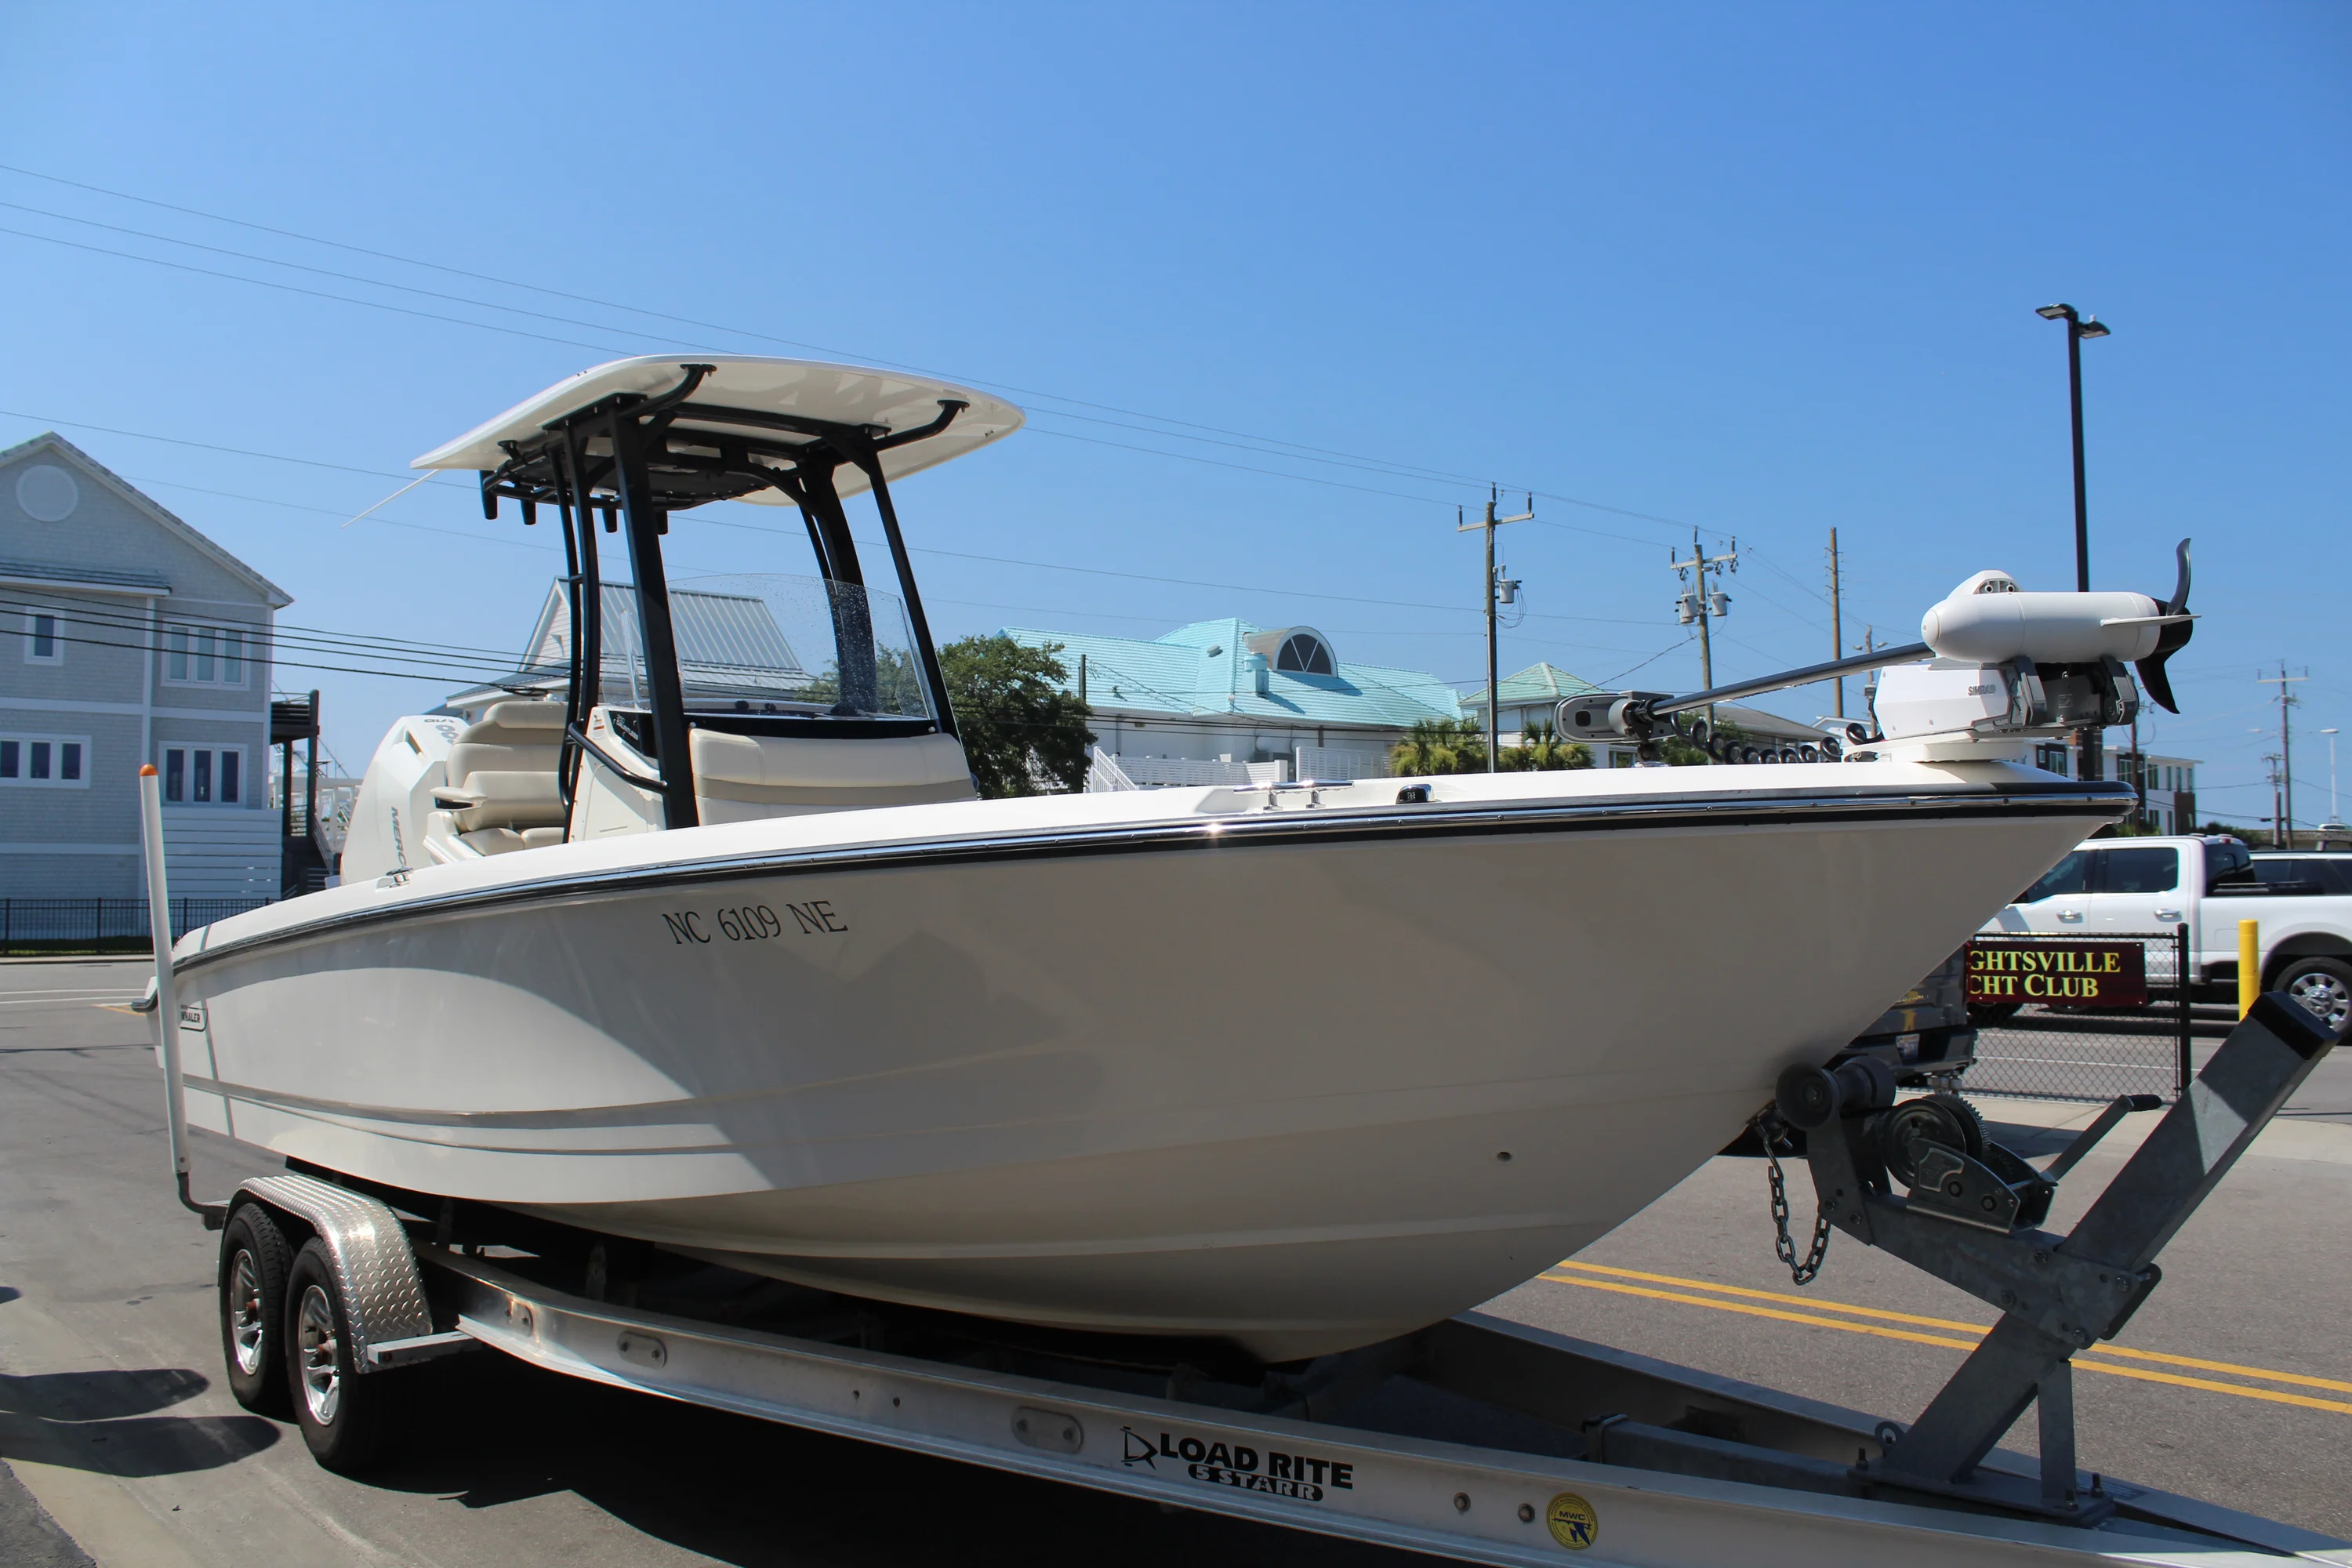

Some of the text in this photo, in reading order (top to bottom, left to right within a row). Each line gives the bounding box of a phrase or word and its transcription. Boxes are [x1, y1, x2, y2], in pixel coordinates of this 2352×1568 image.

[662, 900, 848, 944] NC 6109 NE
[1160, 1432, 1353, 1490] LOAD RITE
[1196, 1465, 1316, 1501] 5 STARR
[1559, 1510, 1586, 1521] MWC
